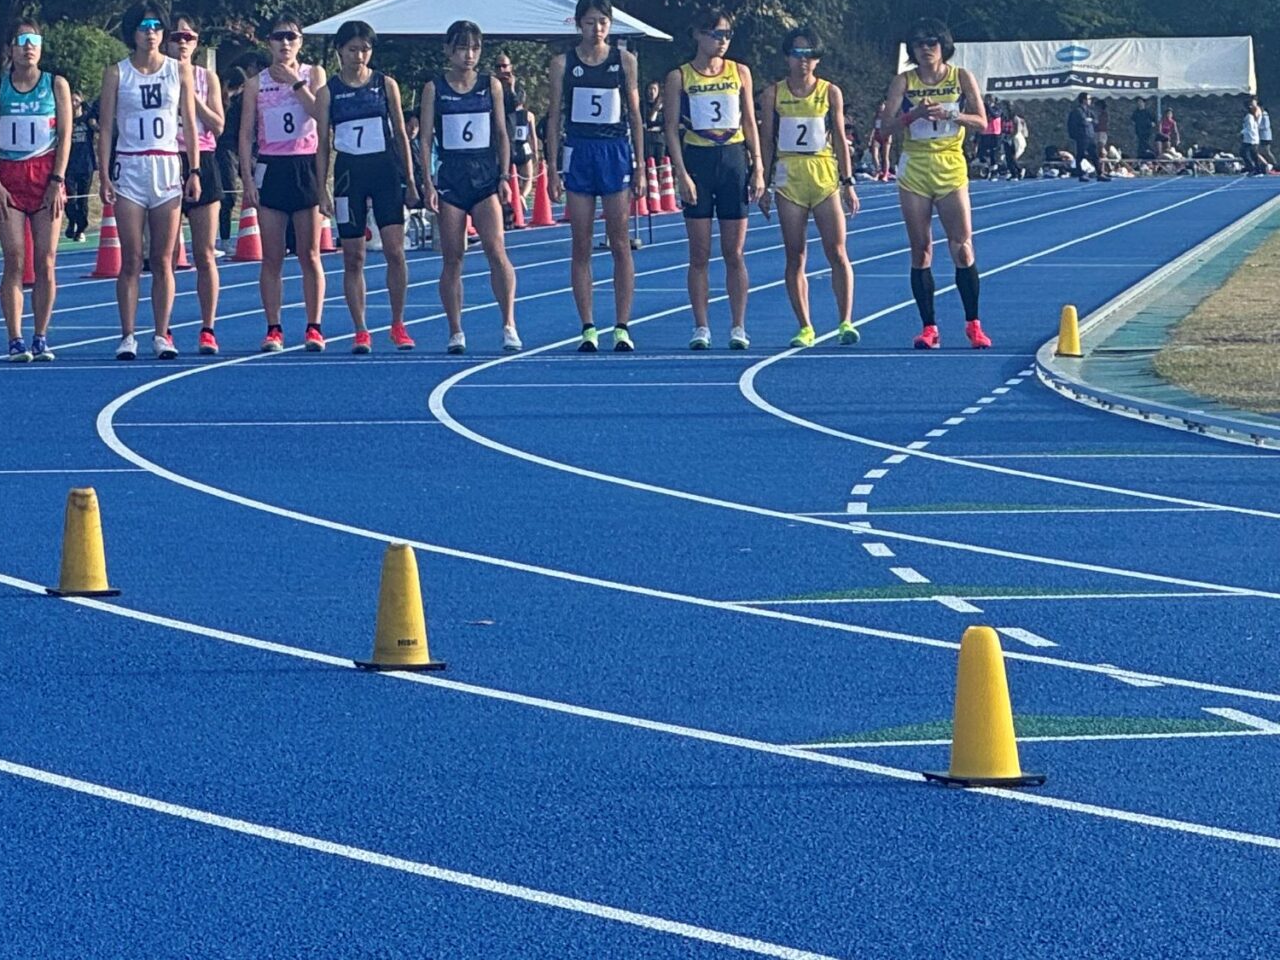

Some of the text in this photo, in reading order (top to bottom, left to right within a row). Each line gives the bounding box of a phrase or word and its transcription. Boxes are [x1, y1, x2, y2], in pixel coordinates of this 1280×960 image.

[688, 81, 738, 94] SUZUKI
[906, 86, 961, 98] SUZUKI
[994, 76, 1152, 89] RUNNING PROJECT
[10, 101, 40, 113] ニトリ
[590, 95, 602, 117] 5
[710, 101, 721, 122] 3
[12, 122, 35, 145] 11
[139, 117, 164, 140] 10
[283, 112, 295, 134] 8
[462, 120, 473, 142] 6
[352, 126, 364, 148] 7
[796, 124, 808, 146] 2
